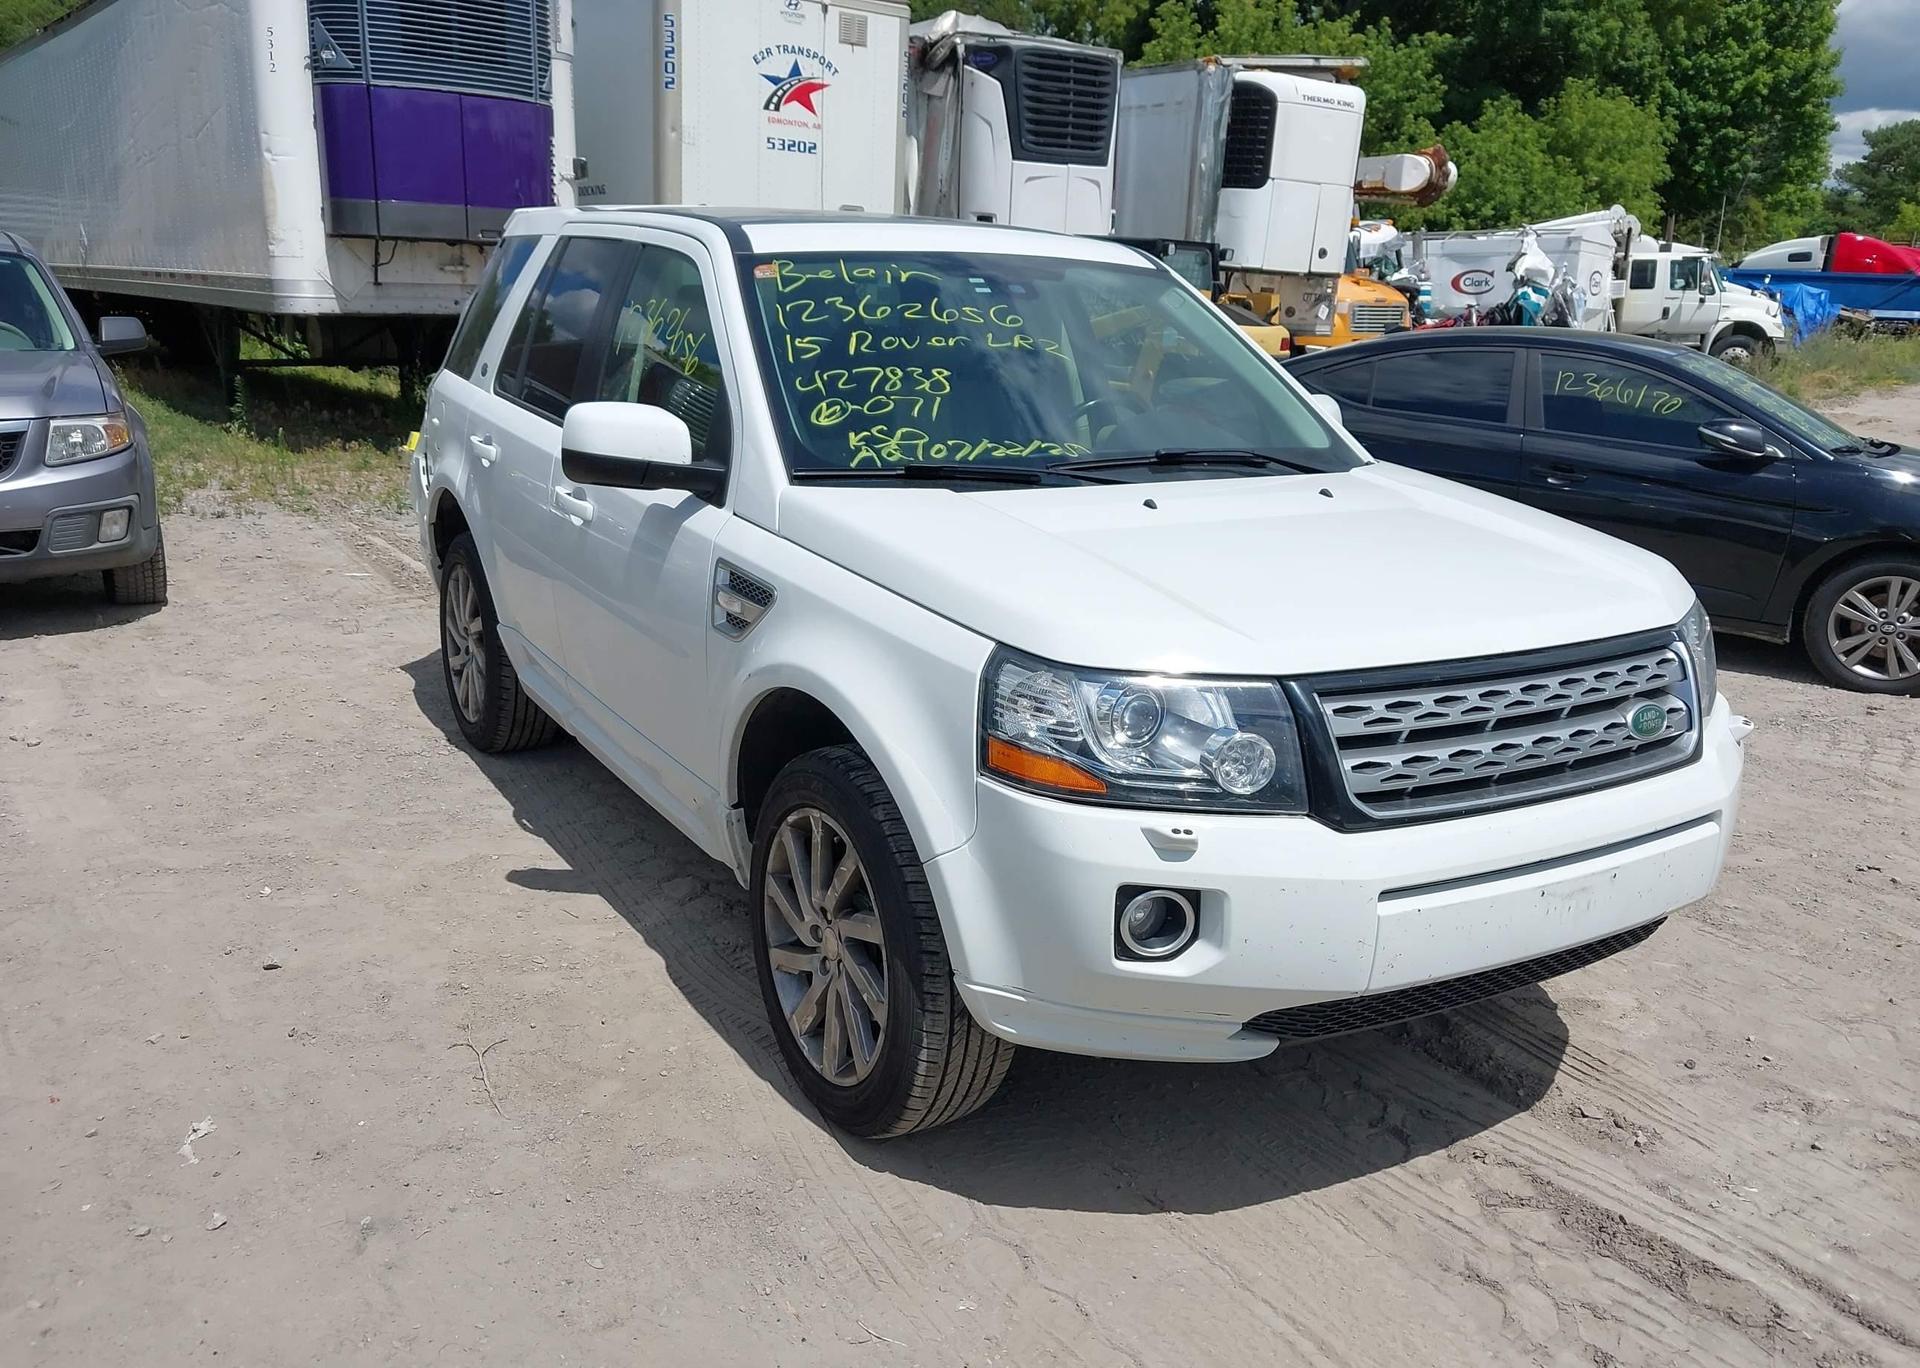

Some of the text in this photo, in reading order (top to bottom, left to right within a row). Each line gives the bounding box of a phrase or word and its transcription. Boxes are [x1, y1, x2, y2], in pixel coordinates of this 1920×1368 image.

[266, 26, 276, 73] 5312
[664, 14, 676, 90] 53202
[752, 44, 840, 77] E2R TRANSPORT
[1302, 94, 1355, 109] THERMO KING
[768, 116, 810, 129] EDMONTON,
[766, 137, 817, 155] 53202
[1463, 276, 1491, 288] Clark
[775, 295, 1024, 328] 12362656
[786, 333, 832, 363] 15
[986, 332, 1072, 361] LR2
[795, 366, 952, 397] 427838
[1555, 370, 1683, 415] 12366170
[1639, 710, 1656, 722] LAND
